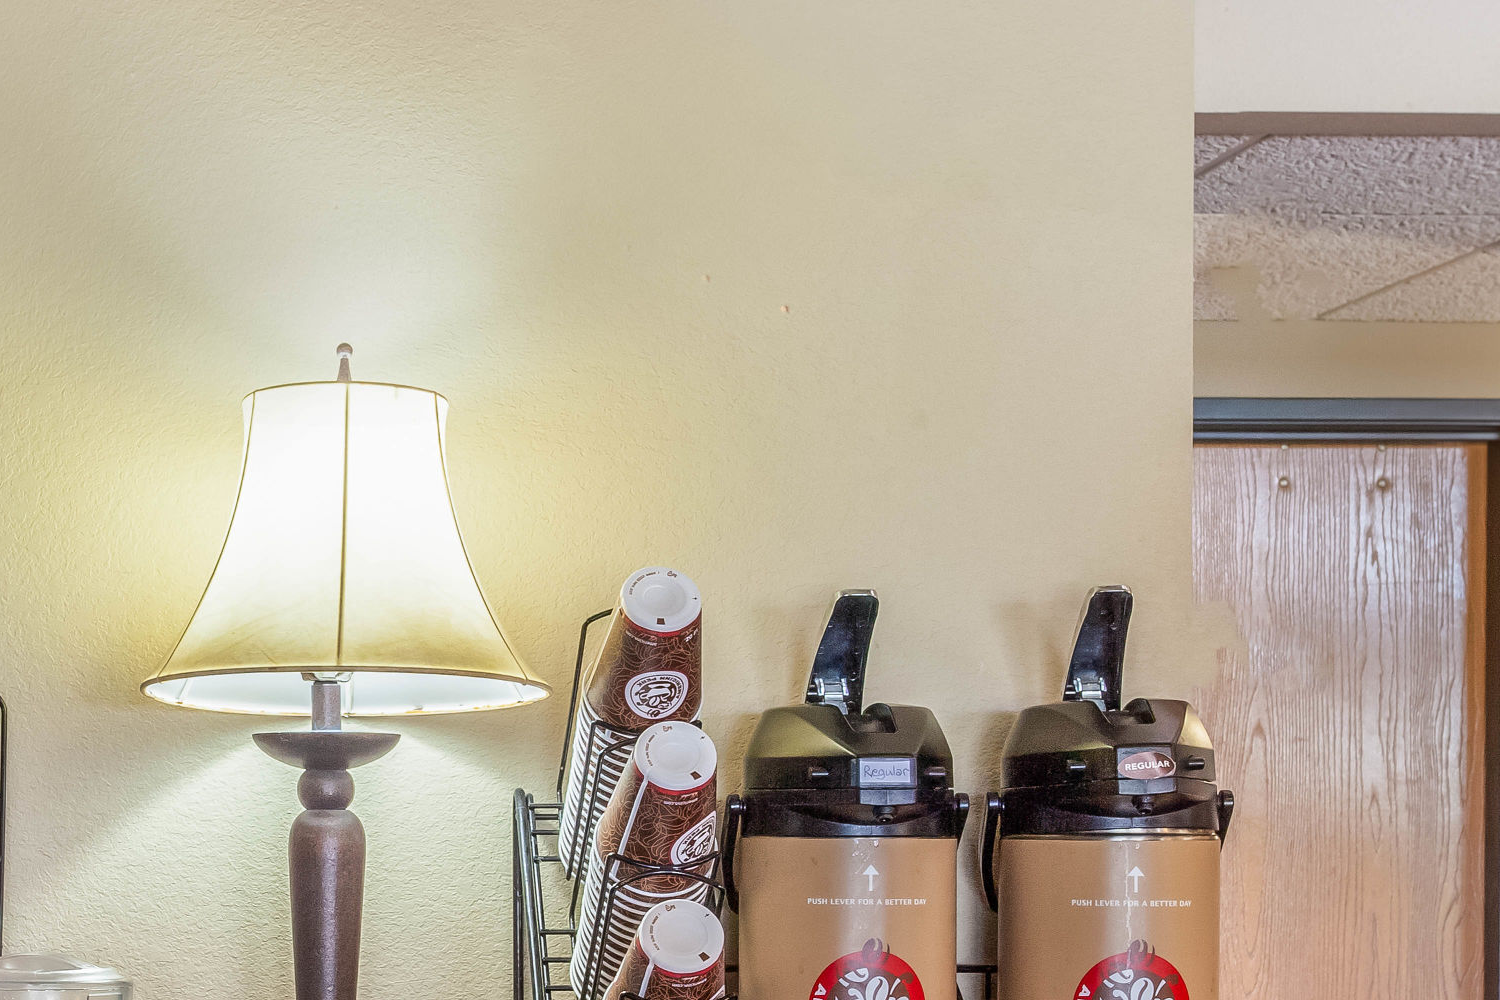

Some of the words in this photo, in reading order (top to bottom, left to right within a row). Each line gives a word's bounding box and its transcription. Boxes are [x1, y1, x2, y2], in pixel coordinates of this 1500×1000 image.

[1124, 760, 1170, 771] REGULAR
[863, 764, 910, 780] Regular
[1071, 899, 1092, 907] PUSH
[1095, 899, 1120, 907] LEVER
[1123, 899, 1139, 907] FOR
[1141, 899, 1148, 907] A
[1150, 899, 1177, 907] BETTER
[1180, 899, 1192, 907] DAY
